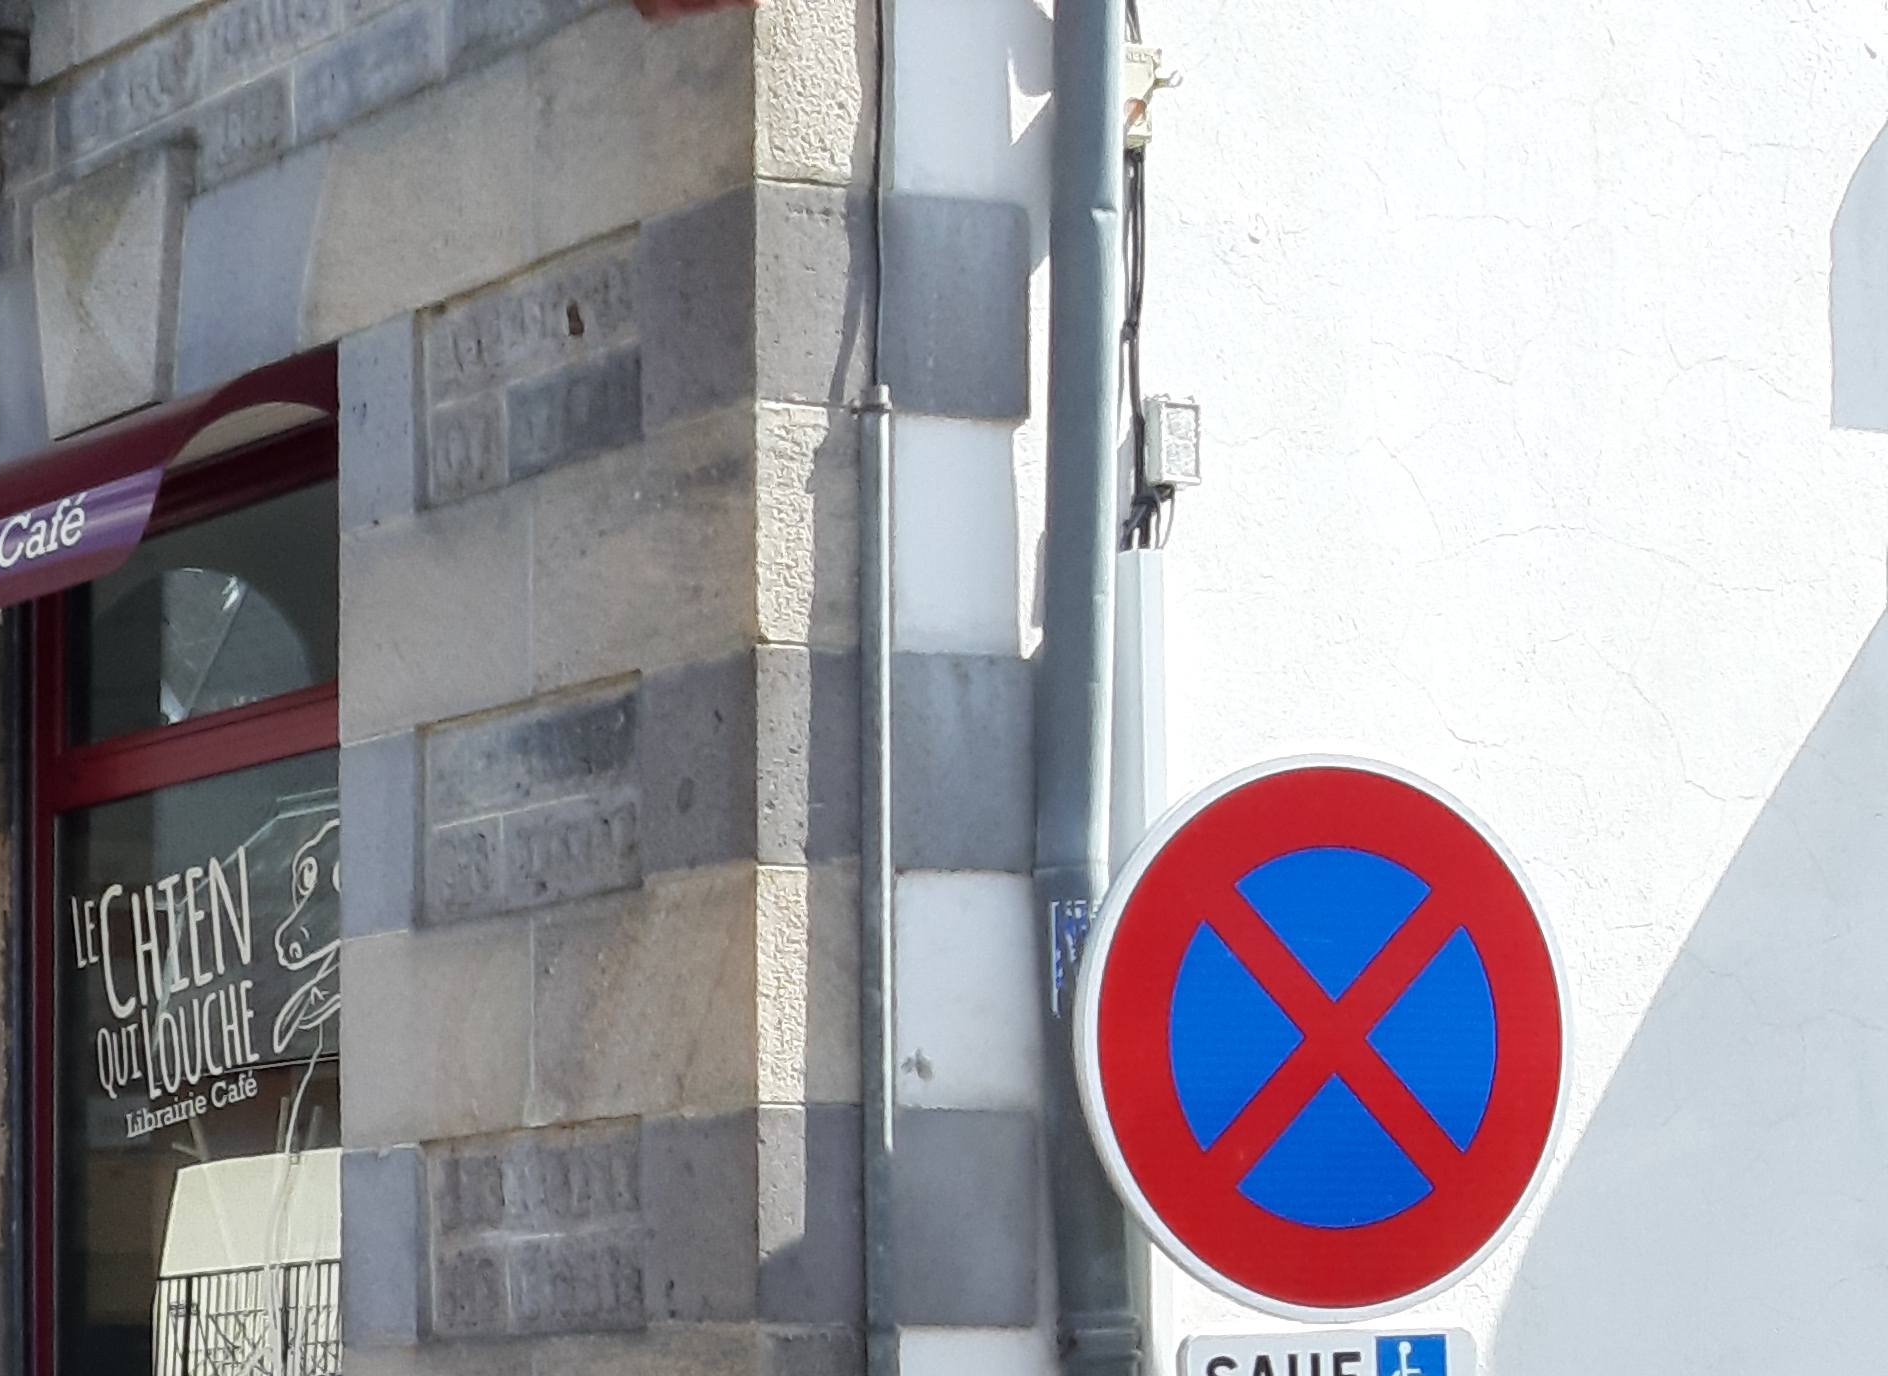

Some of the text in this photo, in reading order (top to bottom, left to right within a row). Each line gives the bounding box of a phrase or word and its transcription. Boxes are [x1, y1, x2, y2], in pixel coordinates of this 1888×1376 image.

[71, 846, 252, 1019] LE CHIEN
[96, 980, 260, 1100] QUI LOUCHE
[125, 1069, 259, 1139] Librairie Café
